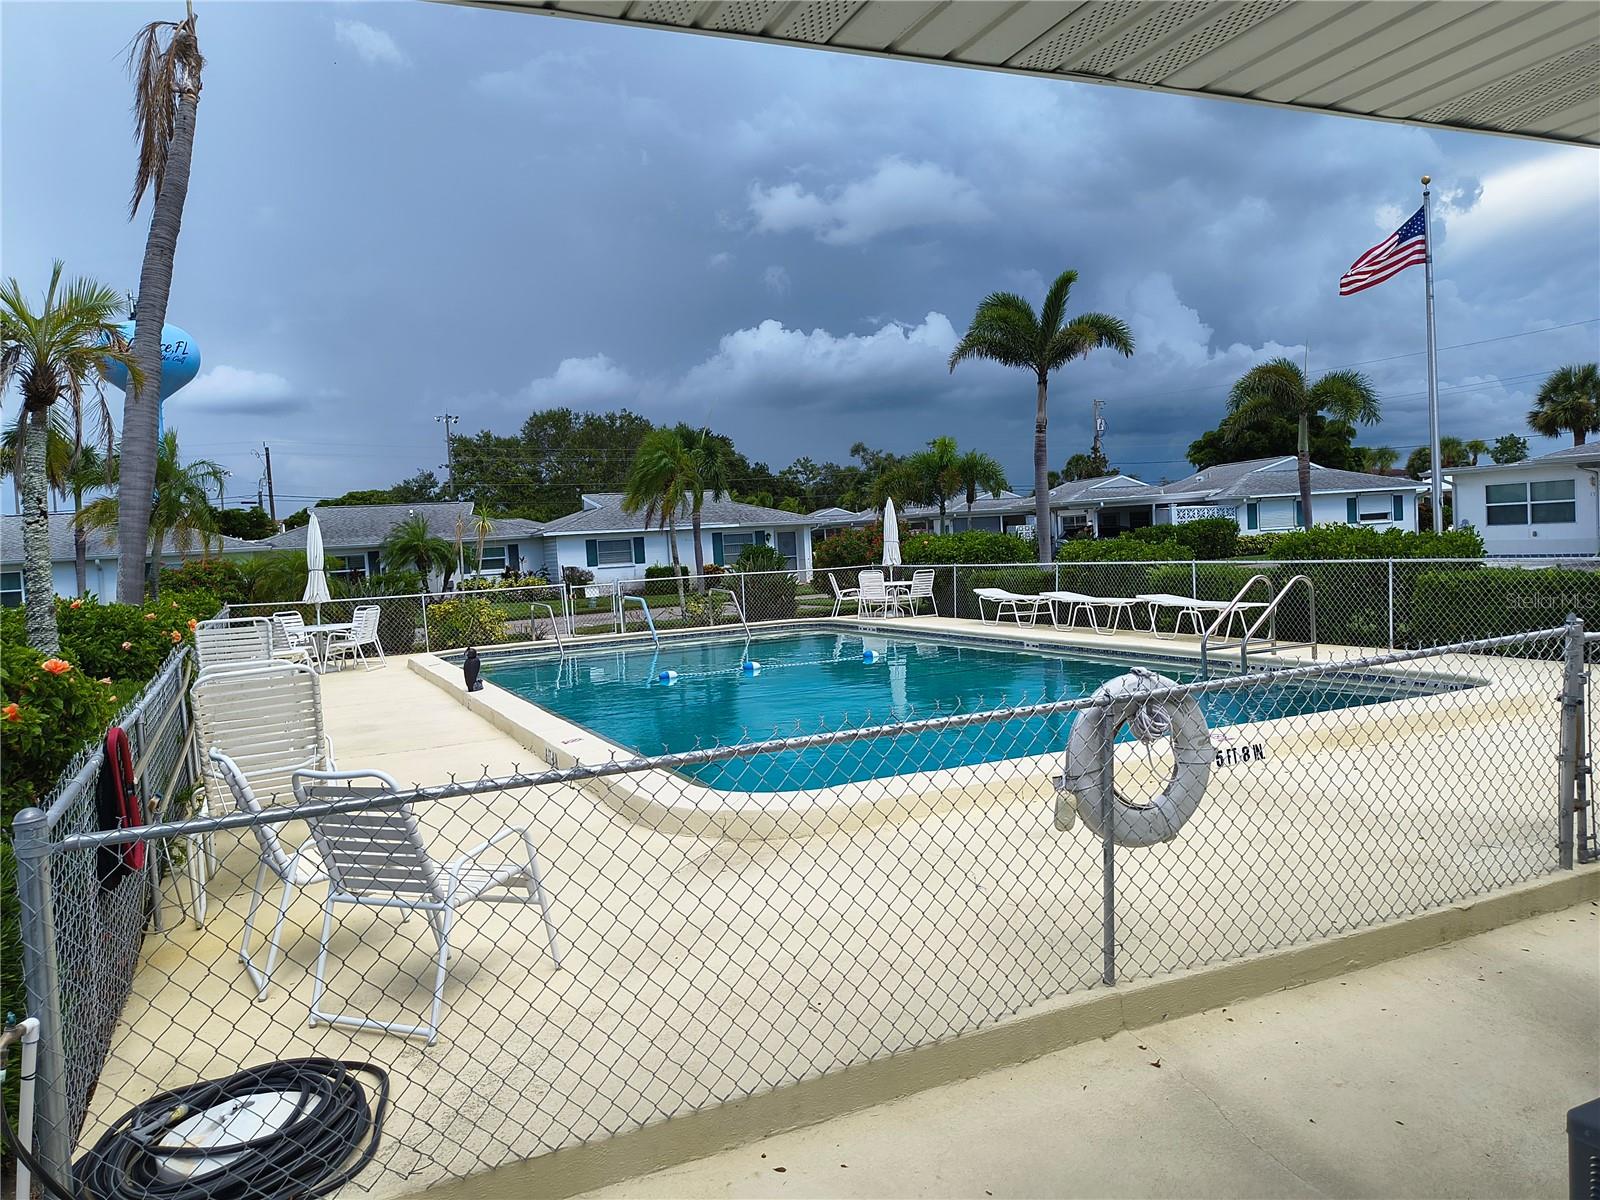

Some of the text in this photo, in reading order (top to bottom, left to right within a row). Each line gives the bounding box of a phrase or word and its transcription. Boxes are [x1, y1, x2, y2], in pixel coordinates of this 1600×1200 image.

[1215, 749, 1225, 767] 5
[1226, 747, 1238, 765] FT
[1241, 745, 1251, 762] 8
